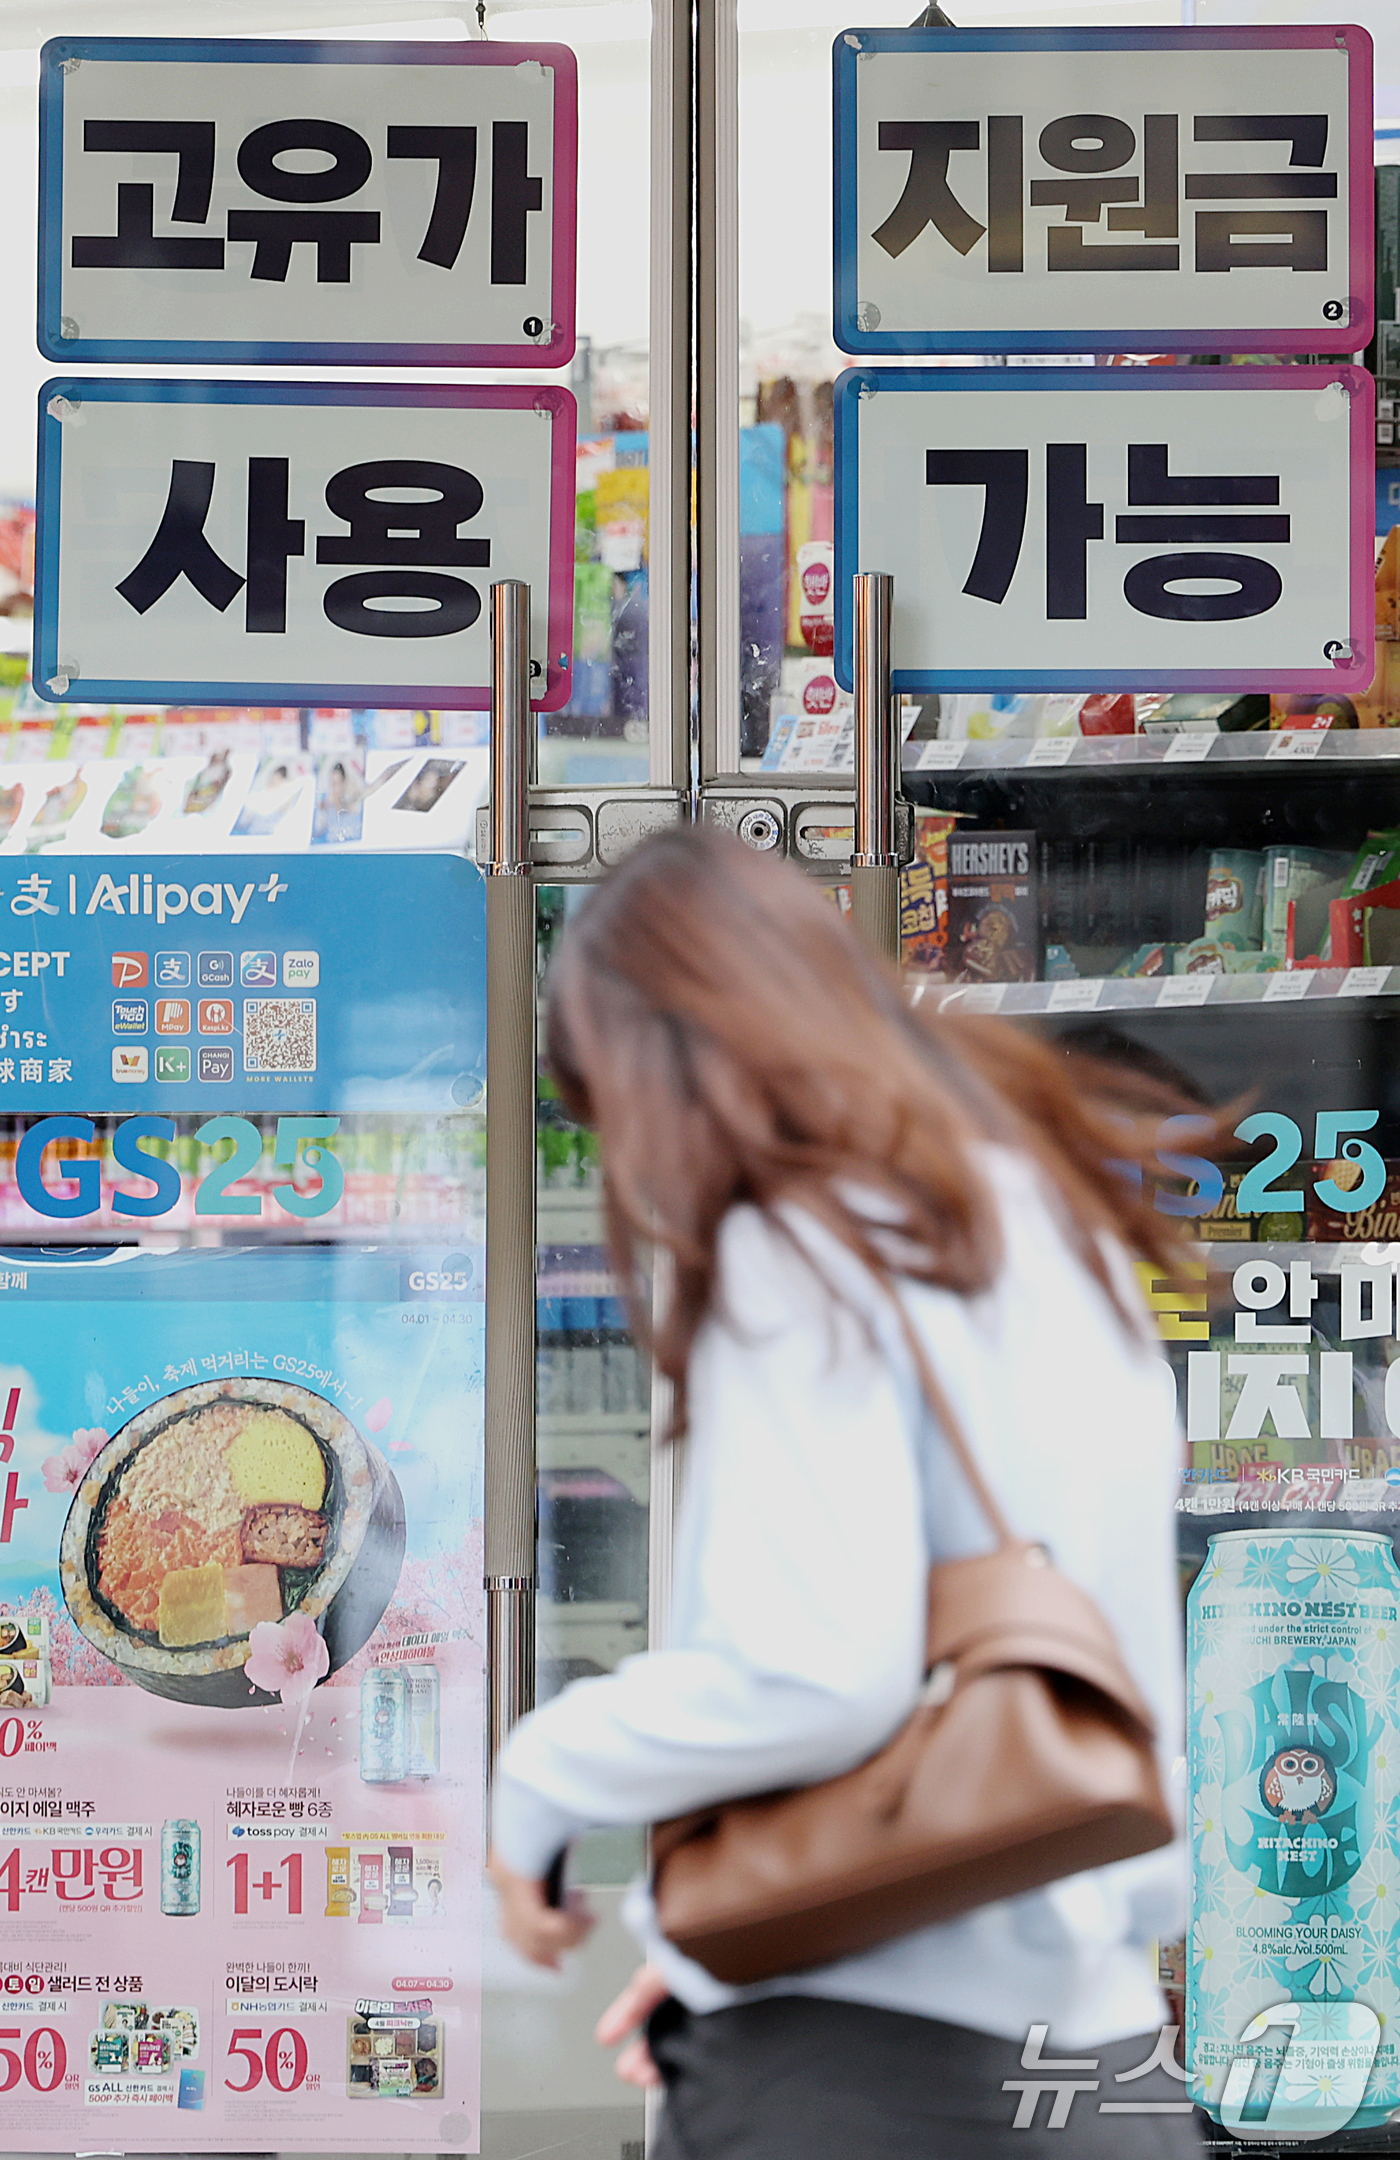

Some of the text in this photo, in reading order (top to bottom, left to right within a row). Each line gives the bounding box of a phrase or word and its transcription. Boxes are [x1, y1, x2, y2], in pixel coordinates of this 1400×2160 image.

[870, 113, 1337, 273] 지원금
[71, 118, 542, 285] 고유가
[1328, 304, 1338, 317] 2
[529, 320, 536, 333] 1
[925, 442, 1291, 622] 가능
[114, 456, 491, 638] 사용
[1311, 717, 1333, 728] 2+1
[952, 843, 1029, 875] HERSHEY'S
[288, 959, 314, 968] Zalo
[202, 974, 230, 982] GCash
[288, 970, 310, 979] pay
[1, 989, 23, 1013] す
[115, 1004, 145, 1014] Touch
[115, 1022, 146, 1030] eWallet
[162, 1024, 184, 1032] MPay
[159, 1056, 187, 1073] K+
[203, 1060, 229, 1078] Pay
[15, 1116, 344, 1218] GS25
[408, 1271, 468, 1291] GS25
[1232, 1260, 1318, 1343] 안
[401, 1314, 472, 1324] 04.01 04.30
[163, 1358, 197, 1381] 축제
[202, 1350, 269, 1373] 먹거리는
[1174, 1497, 1198, 1513] 4캔
[1262, 1500, 1280, 1512] 이상
[1304, 1500, 1314, 1512] 시
[1317, 1500, 1336, 1512] 캔당
[1304, 1601, 1358, 1618] NEST
[1360, 1604, 1397, 1621] BEER
[1258, 1624, 1284, 1633] under
[1286, 1624, 1301, 1633] the
[1304, 1624, 1329, 1633] strict
[1331, 1624, 1361, 1634] control
[1274, 1635, 1357, 1646] BREWERY, JAPAN
[16, 1787, 25, 1798] 안
[226, 1787, 264, 1798] 나들이를
[267, 1787, 276, 1798] 더
[1, 1801, 96, 1818] 이지 에일 맥주
[226, 1801, 333, 1818] 혜자로운 빵 6종
[2, 1826, 153, 1837] 신한카드 우리카드 결제 시
[299, 1827, 328, 1837] 결제 시
[1257, 1837, 1338, 1849] HITACHINO
[1277, 1850, 1317, 1862] NEST
[50, 1847, 143, 1900] 만원
[226, 1853, 302, 1914] 1+1
[100, 1905, 111, 1913] QR
[1236, 1926, 1362, 1939] BLOOMING YOUR DAISY
[25, 1962, 67, 1973] 식단관리!
[226, 1962, 310, 1973] 완벽한 나들이 한끼!
[7, 1976, 143, 1992] 토 일 샐러드 전 상품
[226, 1976, 318, 1992] 이달의 도시락
[395, 1980, 449, 1988] 04.07 04.30
[2, 2001, 67, 2012] 신한카드 결제 시
[299, 2001, 317, 2012] 결제
[319, 2001, 328, 2012] 시
[1220, 2044, 1243, 2055] 지나친
[1246, 2044, 1273, 2056] 음주는
[1310, 2045, 1338, 2057] 기억력
[1341, 2045, 1374, 2057] 손상이나
[1264, 2057, 1292, 2069] 음주는
[65, 2074, 80, 2083] QR
[305, 2074, 321, 2083] QR
[102, 2083, 123, 2092] ALL
[126, 2084, 153, 2092] 신한카드
[89, 2094, 173, 2103] 500P 추가 즉시 페이백
